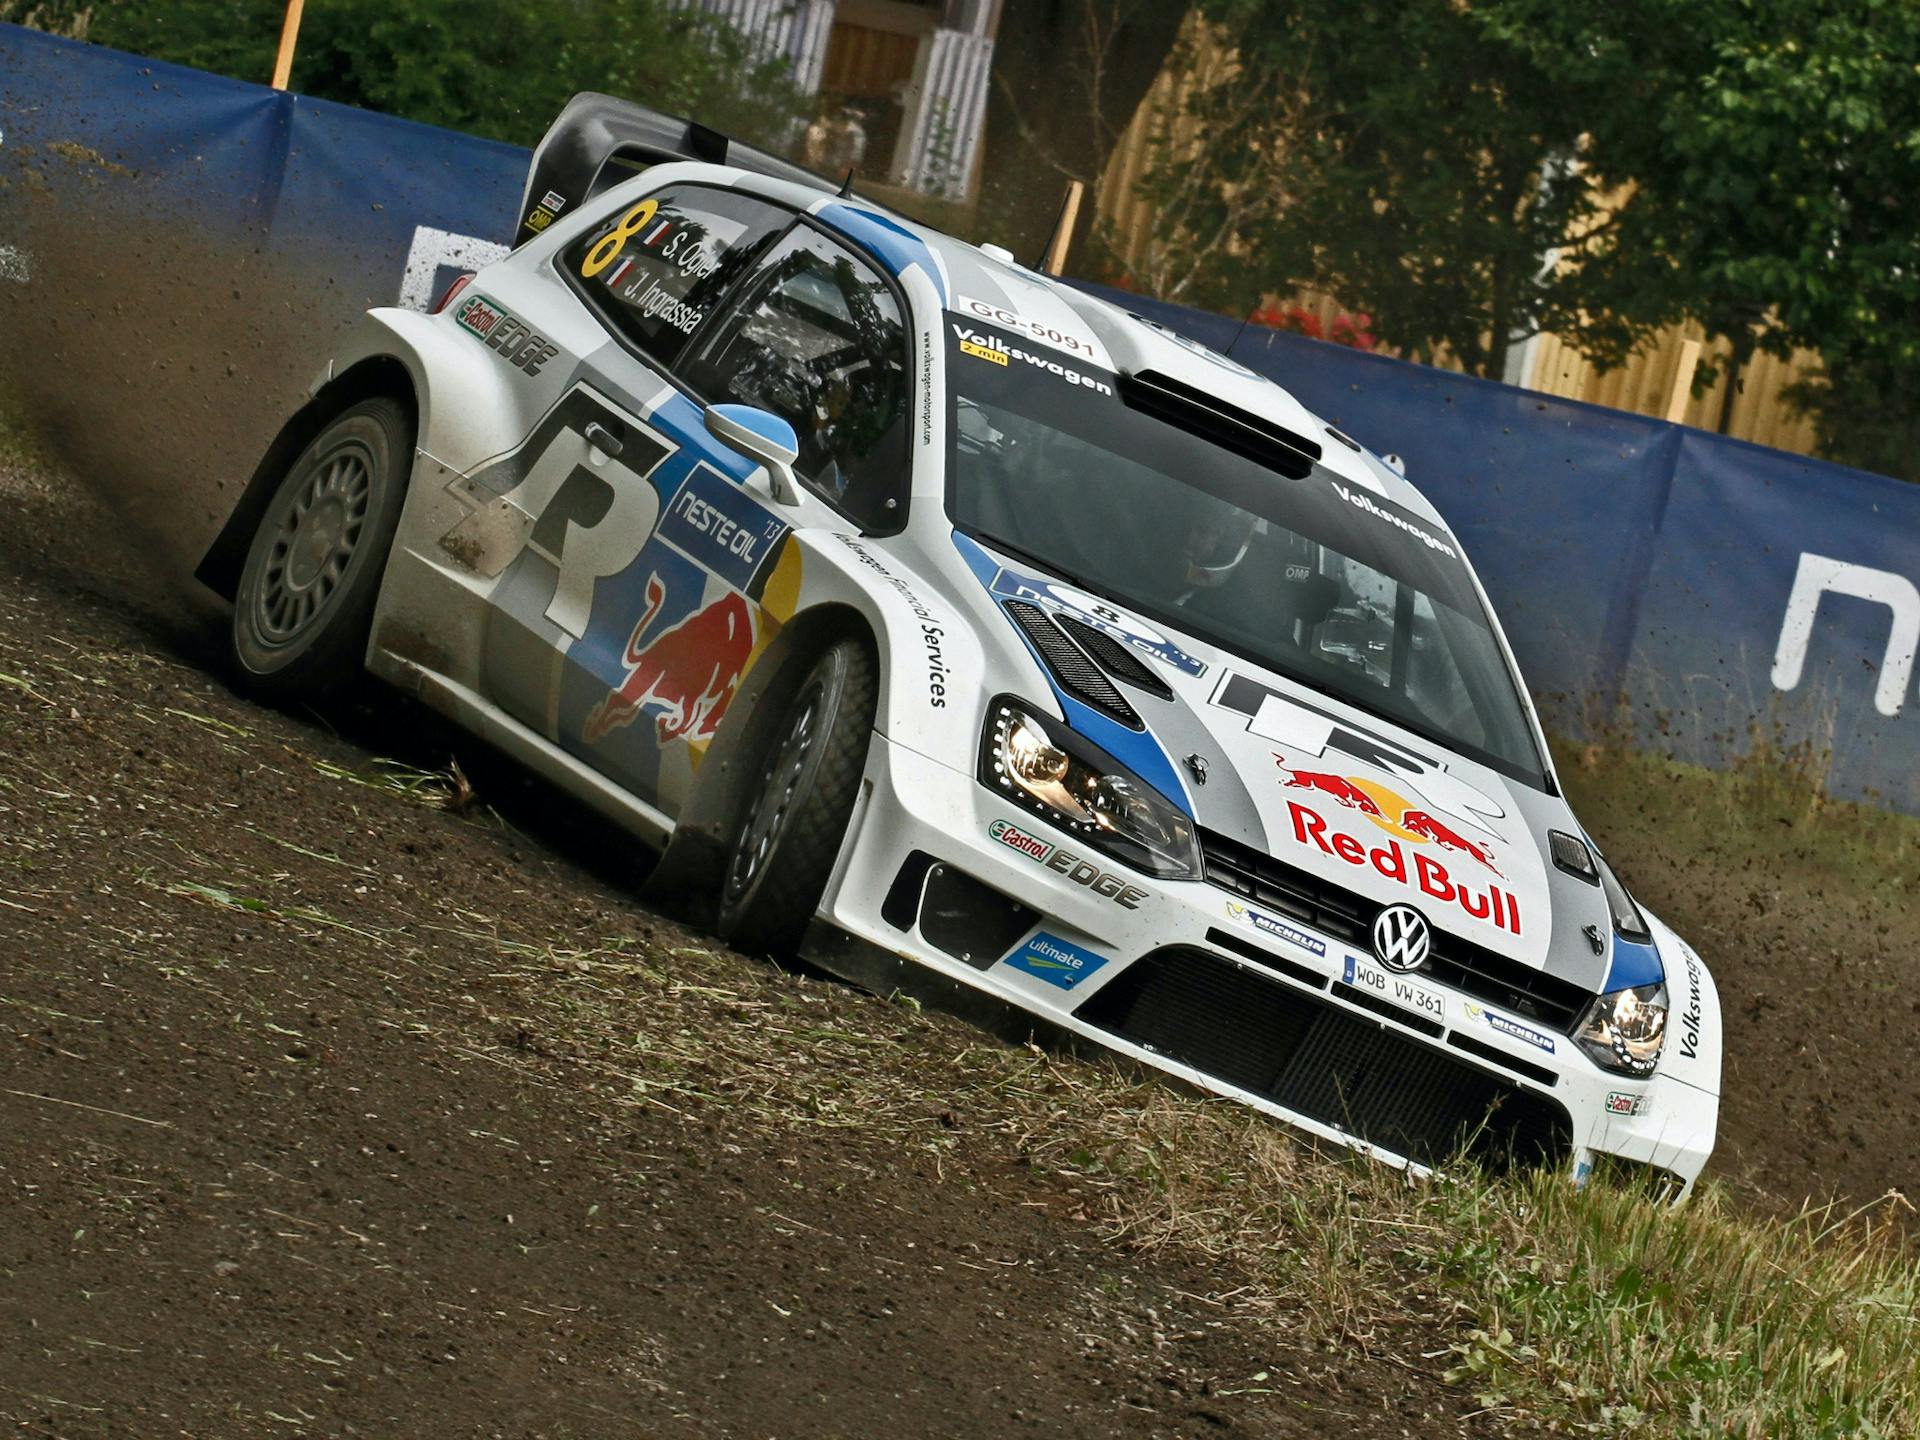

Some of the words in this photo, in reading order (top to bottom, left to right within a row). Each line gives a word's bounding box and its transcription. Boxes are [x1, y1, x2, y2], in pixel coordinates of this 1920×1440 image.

[581, 199, 659, 278] 8
[662, 231, 688, 258] S.
[678, 241, 722, 280] Ogier
[624, 272, 650, 299] J.
[637, 278, 703, 335] Ingrassia
[970, 301, 1095, 357] GG-5091
[485, 316, 559, 377] EDGE
[952, 323, 1112, 396] Volkswagen
[963, 343, 973, 352] 2
[978, 349, 1006, 364] min
[729, 528, 757, 564] OIL
[1331, 481, 1456, 559] Volkswagen
[1090, 604, 1120, 623] 8
[921, 624, 951, 709] Services
[1132, 639, 1178, 666] OIL
[1001, 828, 1049, 859] Castrol
[1045, 849, 1150, 910] EDGE
[1286, 799, 1408, 885] Red
[1413, 851, 1522, 936] Bull
[1028, 938, 1084, 970] ultimate
[1255, 916, 1324, 953] MICHELIN
[1357, 965, 1386, 990] WOB
[1395, 981, 1413, 1003] VW
[1416, 990, 1443, 1016] 361
[1679, 942, 1701, 1059] Volkswagen
[1491, 1016, 1553, 1050] MICHELIN
